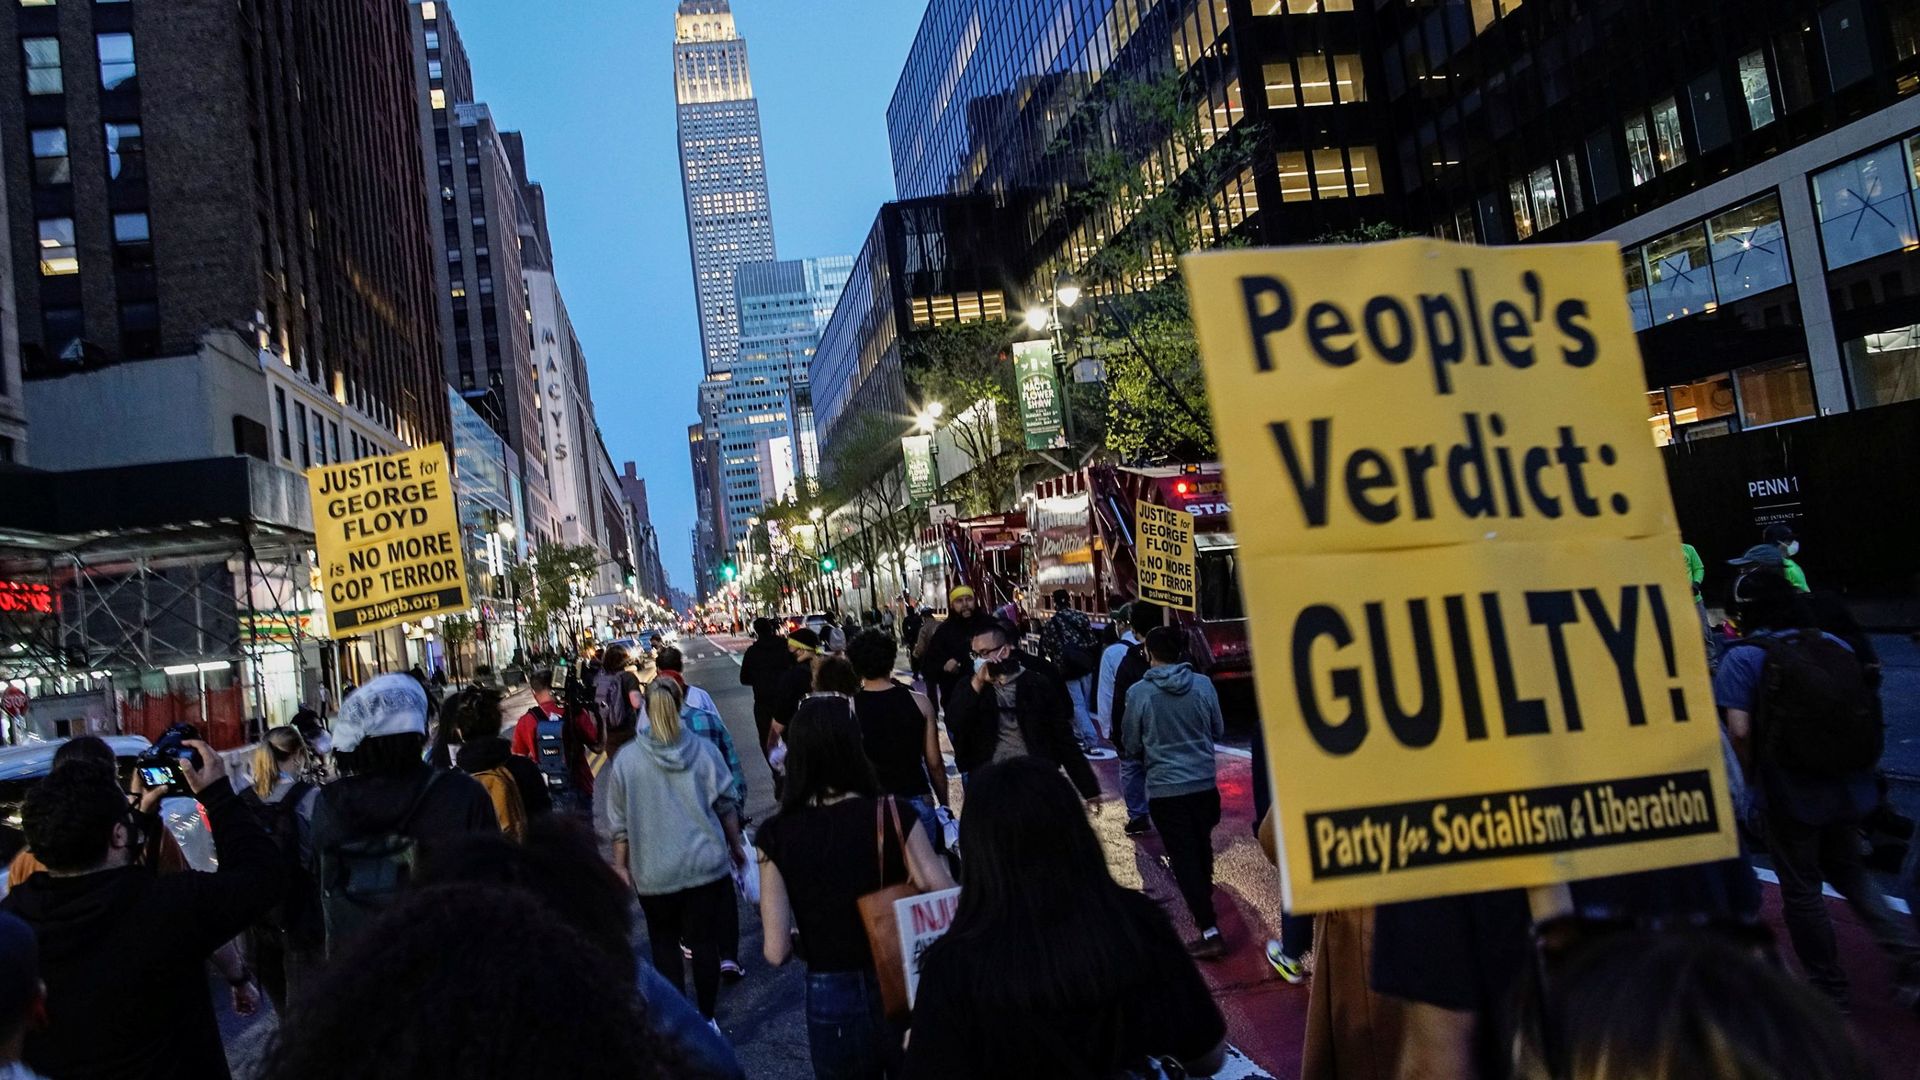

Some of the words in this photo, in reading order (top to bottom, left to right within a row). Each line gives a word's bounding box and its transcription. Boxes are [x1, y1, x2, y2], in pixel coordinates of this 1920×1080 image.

[1238, 267, 1599, 395] People's
[1022, 390, 1054, 402] FLOWER
[1027, 399, 1051, 409] SHOW
[319, 457, 412, 496] JUSTICE
[419, 461, 440, 477] for
[1267, 411, 1630, 528] Verdict:
[328, 480, 438, 520] GEORGE
[1748, 477, 1790, 498] PENN
[1792, 476, 1799, 493] 1
[1139, 504, 1177, 527] JUSTICE
[1180, 518, 1190, 530] for
[1184, 502, 1233, 516] STA
[343, 507, 428, 542] FLOYD
[1141, 522, 1188, 544] GEORGE
[329, 563, 345, 578] is
[349, 547, 381, 574] NO
[387, 532, 453, 564] MORE
[1041, 533, 1087, 556] Demolition
[1146, 538, 1182, 557] FLOYD
[1140, 557, 1146, 567] is
[1147, 556, 1163, 570] NO
[1165, 558, 1192, 576] MORE
[331, 575, 373, 604] COP
[380, 558, 460, 594] TERROR
[1140, 569, 1157, 585] COP
[1160, 573, 1192, 592] TERROR
[356, 593, 440, 626] pslweb.org
[1291, 583, 1690, 758] GUILTY!
[4, 695, 26, 709] STOP
[1314, 812, 1390, 875] Party
[1398, 815, 1430, 864] for
[1432, 796, 1569, 856] Socialism
[1570, 799, 1586, 839] &
[1585, 781, 1710, 836] Liberation
